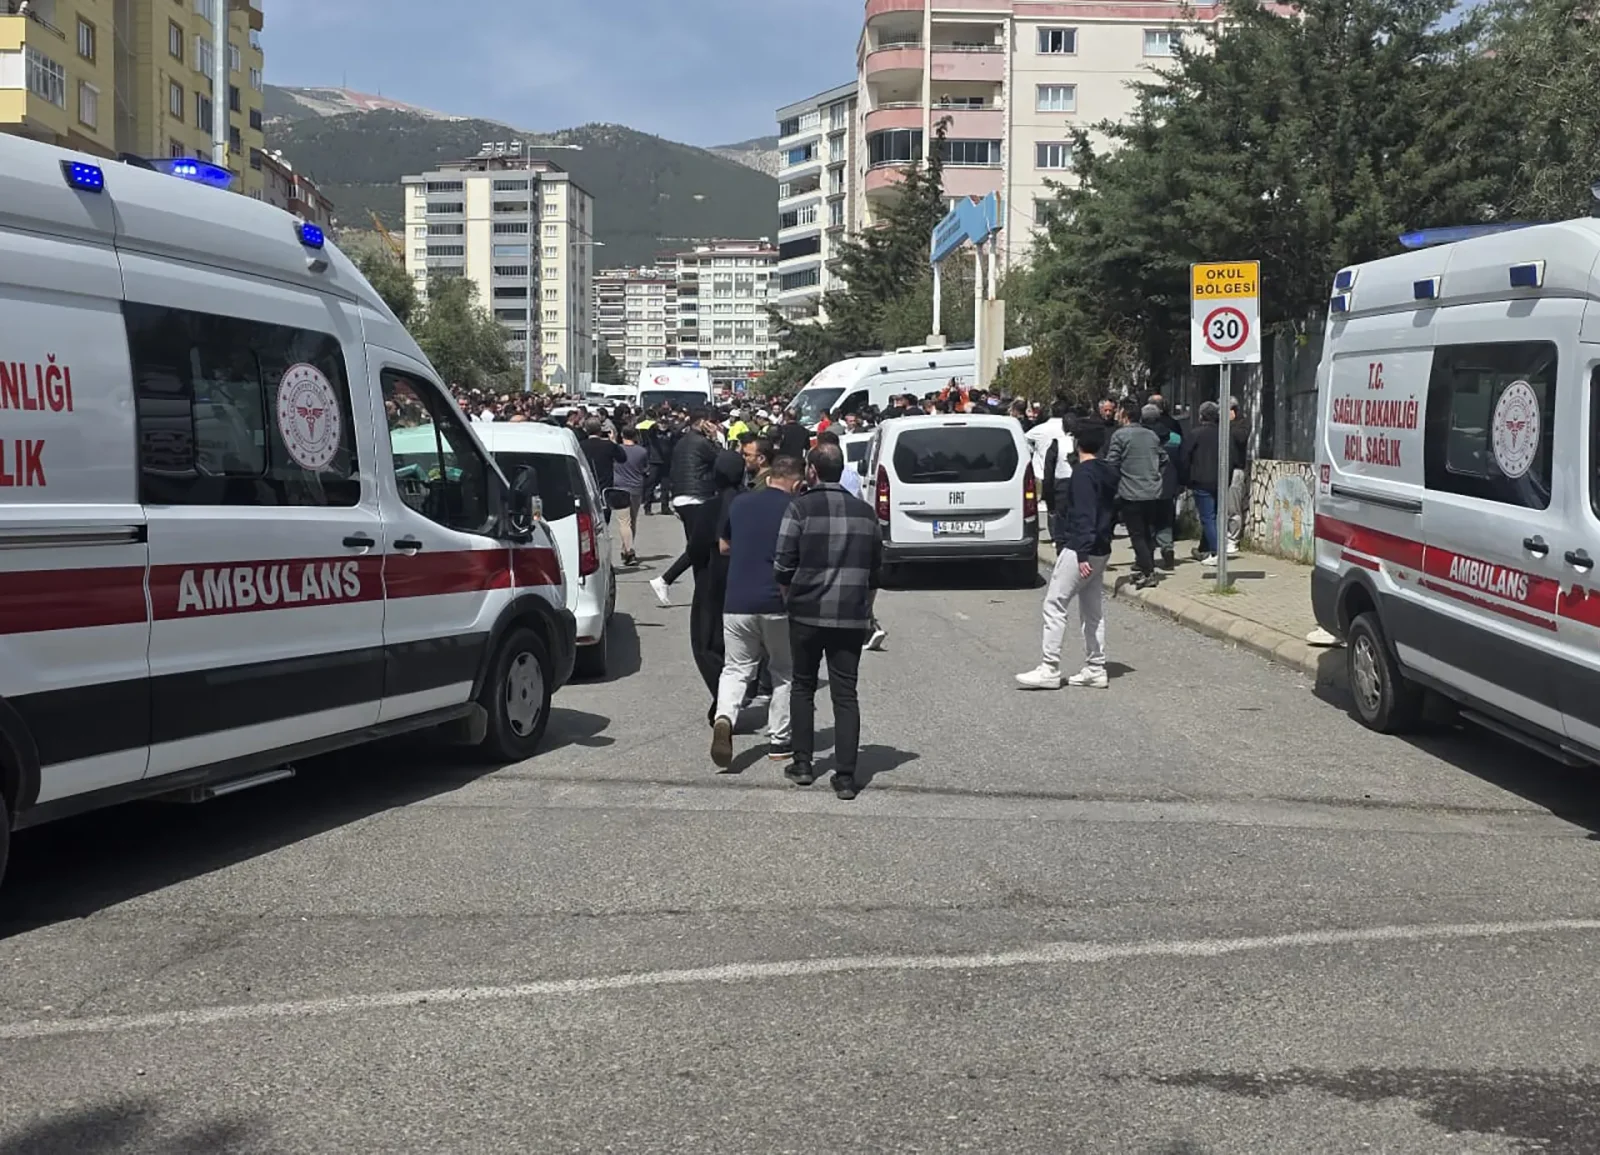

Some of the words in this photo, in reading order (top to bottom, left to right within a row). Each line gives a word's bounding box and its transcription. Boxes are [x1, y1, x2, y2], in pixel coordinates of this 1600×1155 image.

[1195, 280, 1256, 295] BÖLGESİ
[1206, 269, 1245, 279] OKUL
[1212, 319, 1239, 340] 30
[0, 352, 73, 412] NLIĞI
[1368, 362, 1384, 389] T.C.
[1333, 394, 1363, 424] SAĞLIK
[1365, 395, 1419, 430] BAKANLIĞI
[1344, 430, 1364, 461] ACİL
[1365, 433, 1401, 467] SAĞLIK
[948, 491, 965, 505] FIAT
[177, 560, 361, 612] AMBULANS
[1449, 556, 1529, 601] AMBULANS
